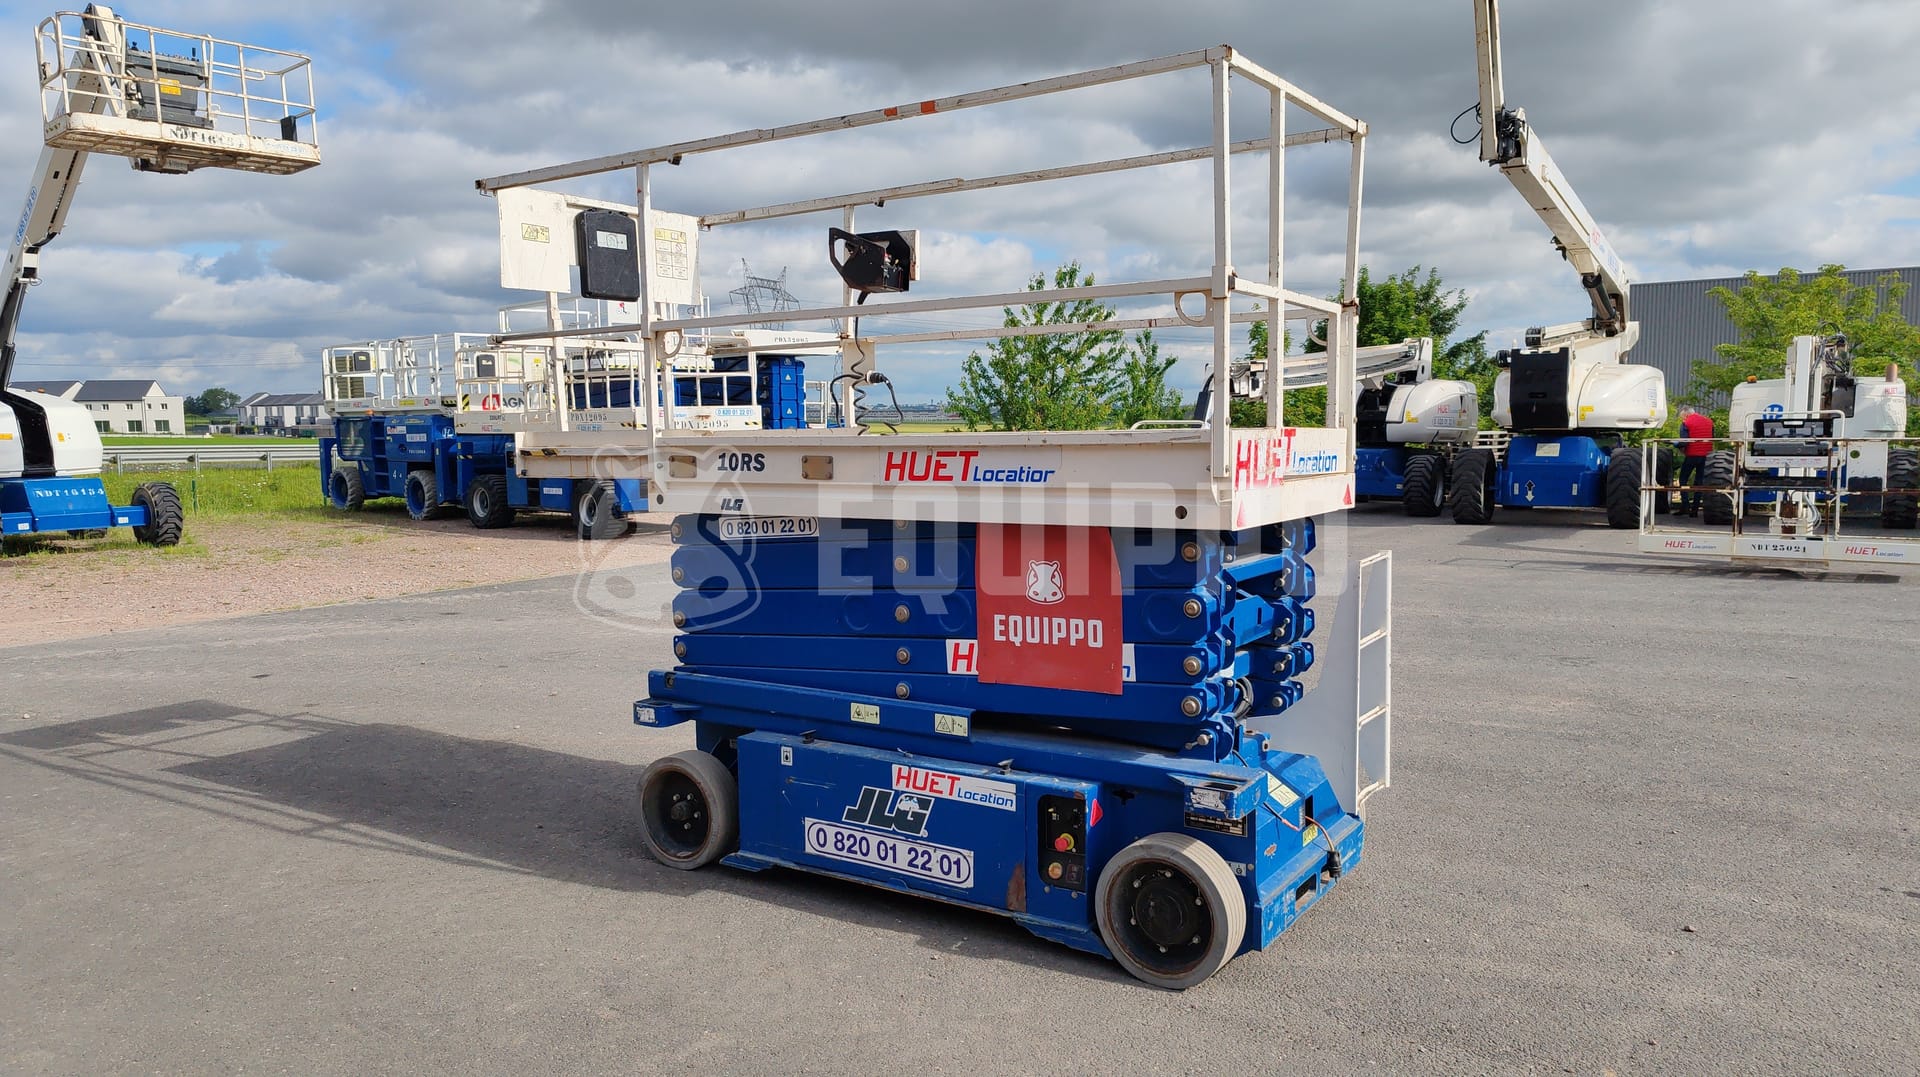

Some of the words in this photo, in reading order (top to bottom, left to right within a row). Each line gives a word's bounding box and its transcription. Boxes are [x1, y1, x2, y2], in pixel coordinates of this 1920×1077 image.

[717, 452, 766, 472] 10RS
[885, 450, 979, 482] HUET
[727, 521, 734, 536] 0
[737, 519, 758, 536] 820
[762, 518, 776, 534] 01
[780, 517, 795, 533] 22
[799, 516, 813, 532] 01
[1844, 546, 1878, 556] HUET
[993, 614, 1104, 649] EQUIPPO
[895, 766, 961, 797] HUET
[957, 787, 1014, 808] Location
[842, 785, 936, 837] JLG
[815, 827, 828, 849] 0
[833, 830, 871, 857] 820
[876, 839, 898, 864] 01
[907, 846, 933, 872] 22
[939, 853, 962, 879] 01
